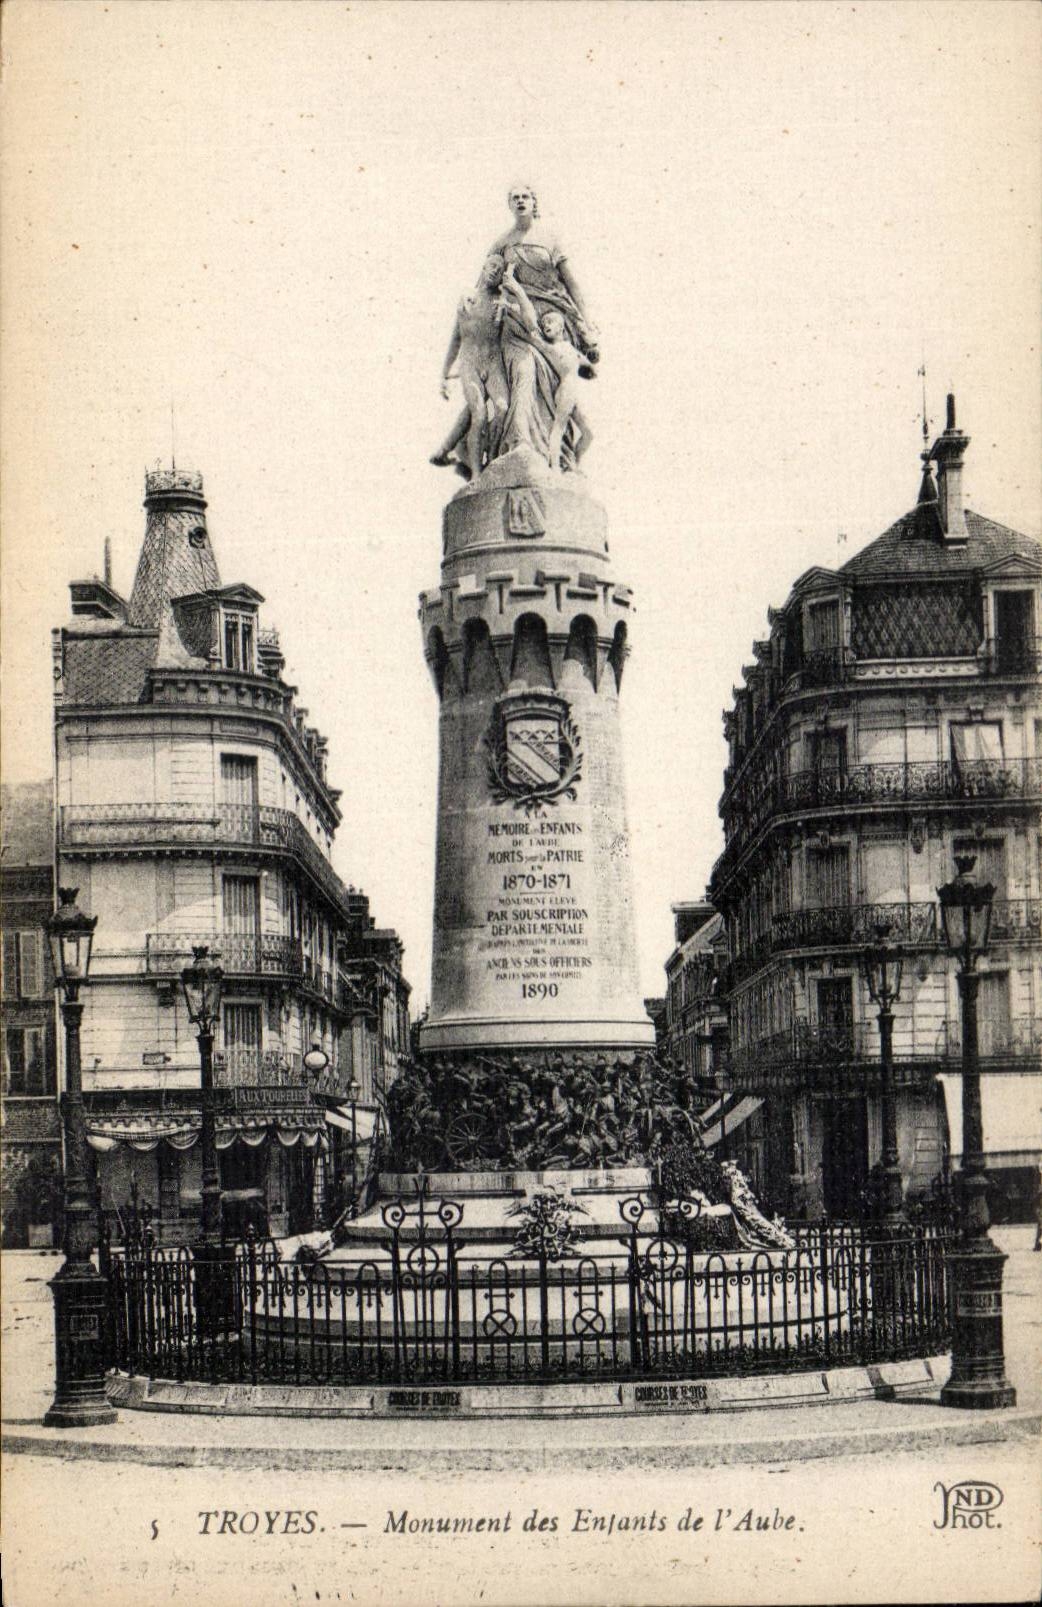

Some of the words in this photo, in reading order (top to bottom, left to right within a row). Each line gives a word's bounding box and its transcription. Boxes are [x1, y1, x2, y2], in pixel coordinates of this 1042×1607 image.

[540, 822, 583, 835] ENFANTS
[512, 839, 524, 847] DE
[487, 850, 524, 864] MORTS
[546, 850, 584, 862] PATRIE
[503, 874, 571, 890] 1870-1871
[498, 897, 545, 906] MONUMENT
[487, 910, 508, 922] PAR
[512, 908, 588, 921] SOUSCRIPTION
[549, 956, 592, 968] OFFICIERS
[522, 983, 559, 1000] 1890
[240, 1089, 259, 1102] AUX
[261, 1089, 307, 1103] TOURELLES
